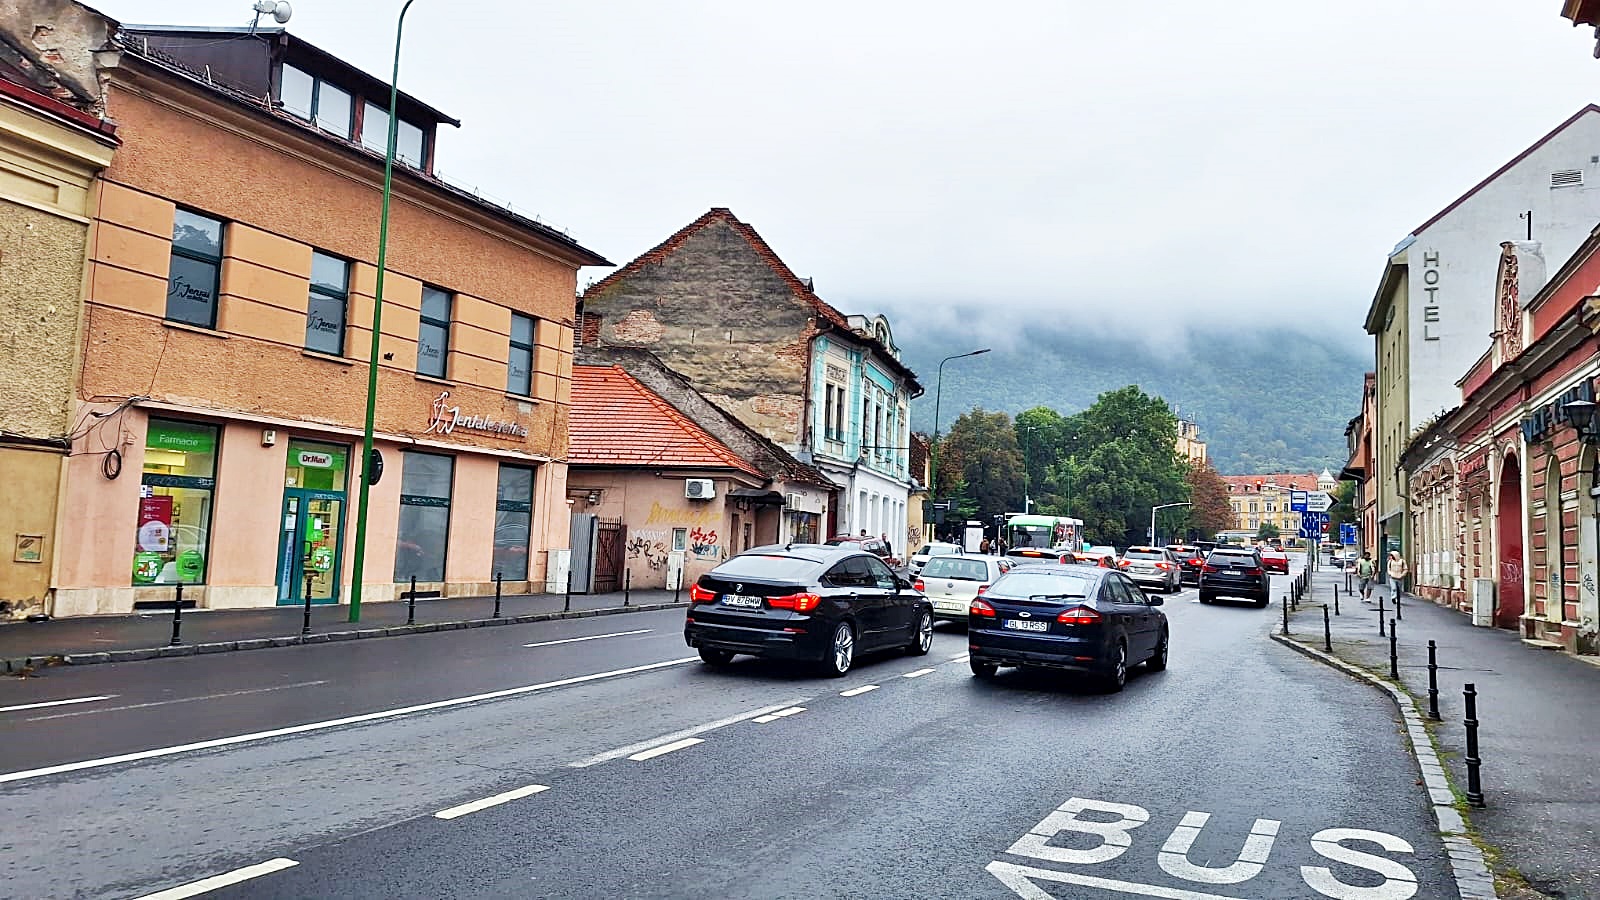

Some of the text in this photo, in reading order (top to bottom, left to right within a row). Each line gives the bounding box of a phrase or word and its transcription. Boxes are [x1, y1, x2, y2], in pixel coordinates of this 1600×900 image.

[1423, 251, 1440, 341] HOTEL
[160, 434, 199, 446] Farmacie
[1004, 797, 1419, 900] BUS
